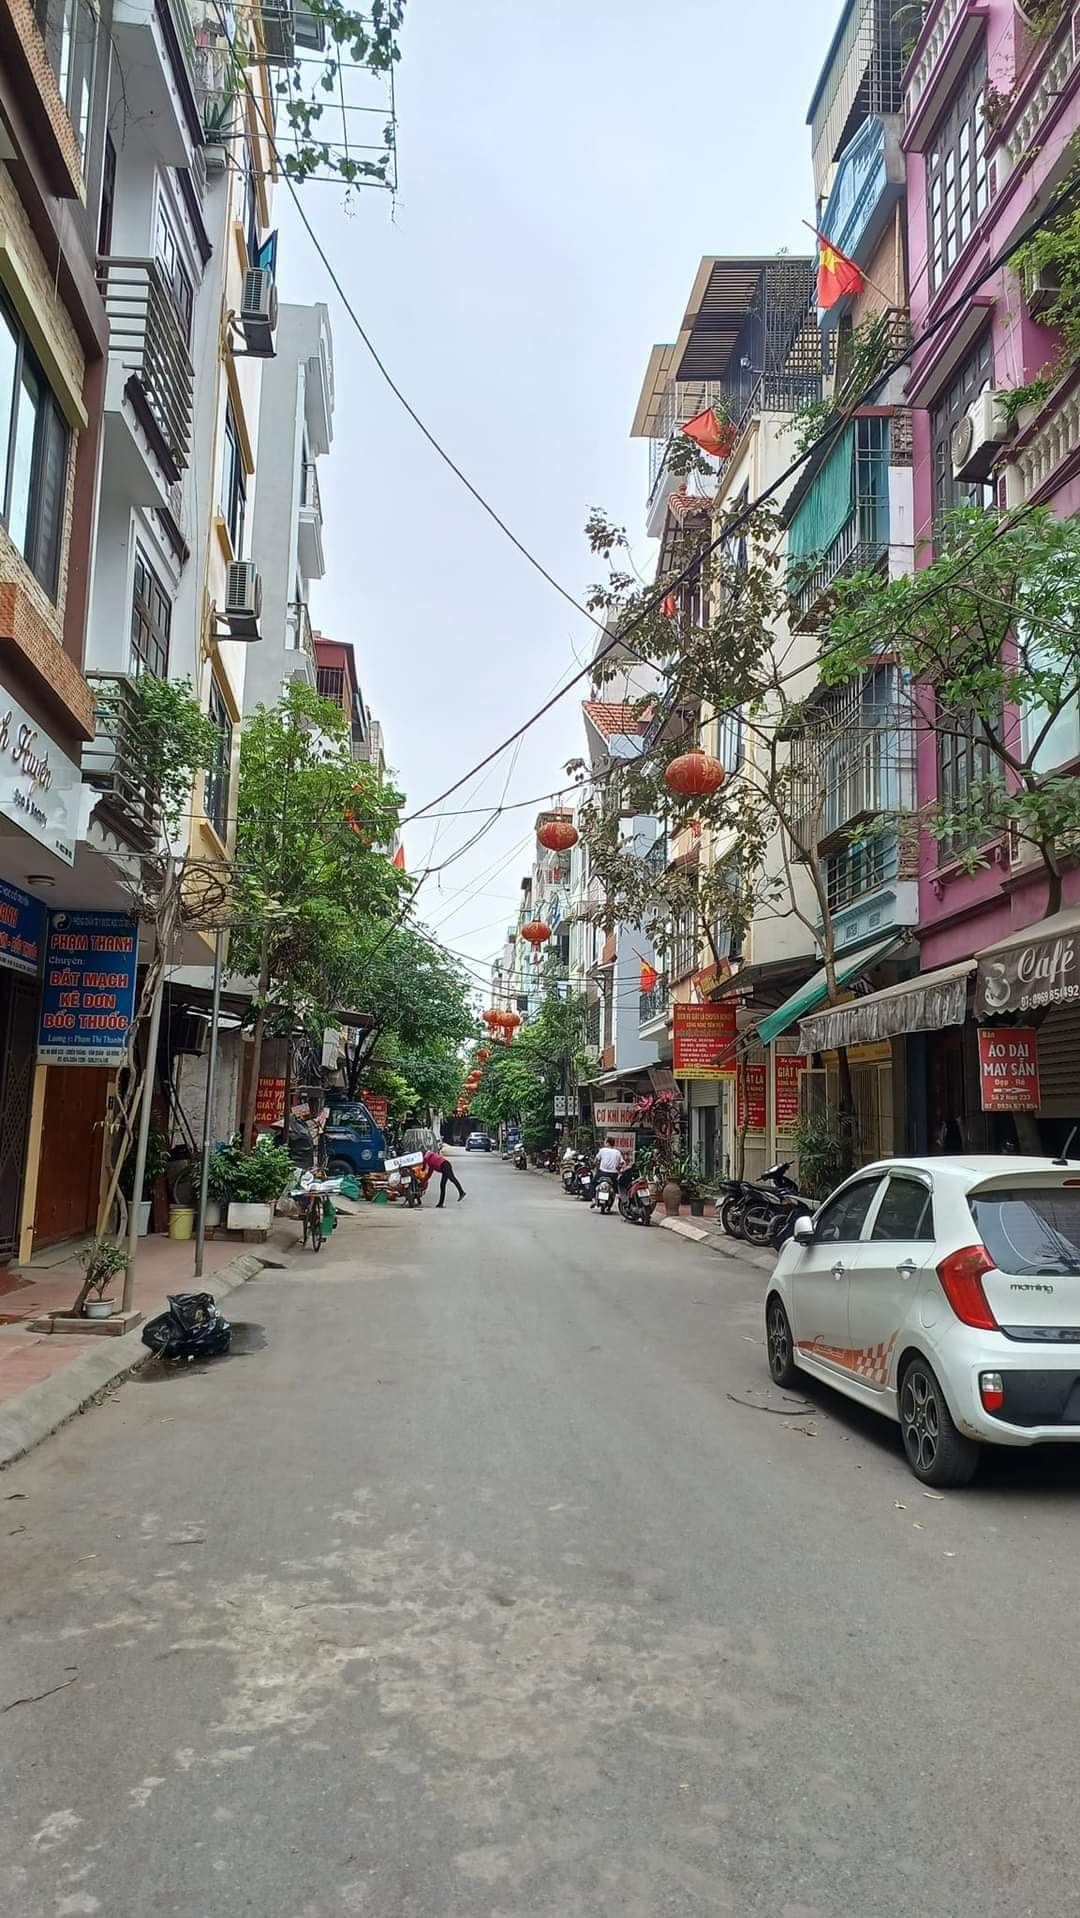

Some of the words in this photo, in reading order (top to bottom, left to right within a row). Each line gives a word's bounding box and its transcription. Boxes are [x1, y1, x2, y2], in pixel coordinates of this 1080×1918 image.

[51, 934, 88, 953] PHẠM
[91, 935, 133, 952] THANH
[1018, 936, 1077, 984] Café
[82, 972, 129, 990] MẠCH
[43, 1008, 75, 1029] BỐC
[79, 1010, 129, 1031] THUỐC
[988, 1041, 1006, 1057] ÁO
[1009, 1041, 1029, 1057] DÀI
[983, 1063, 1008, 1076] MAY
[1010, 1283, 1054, 1295] morning
